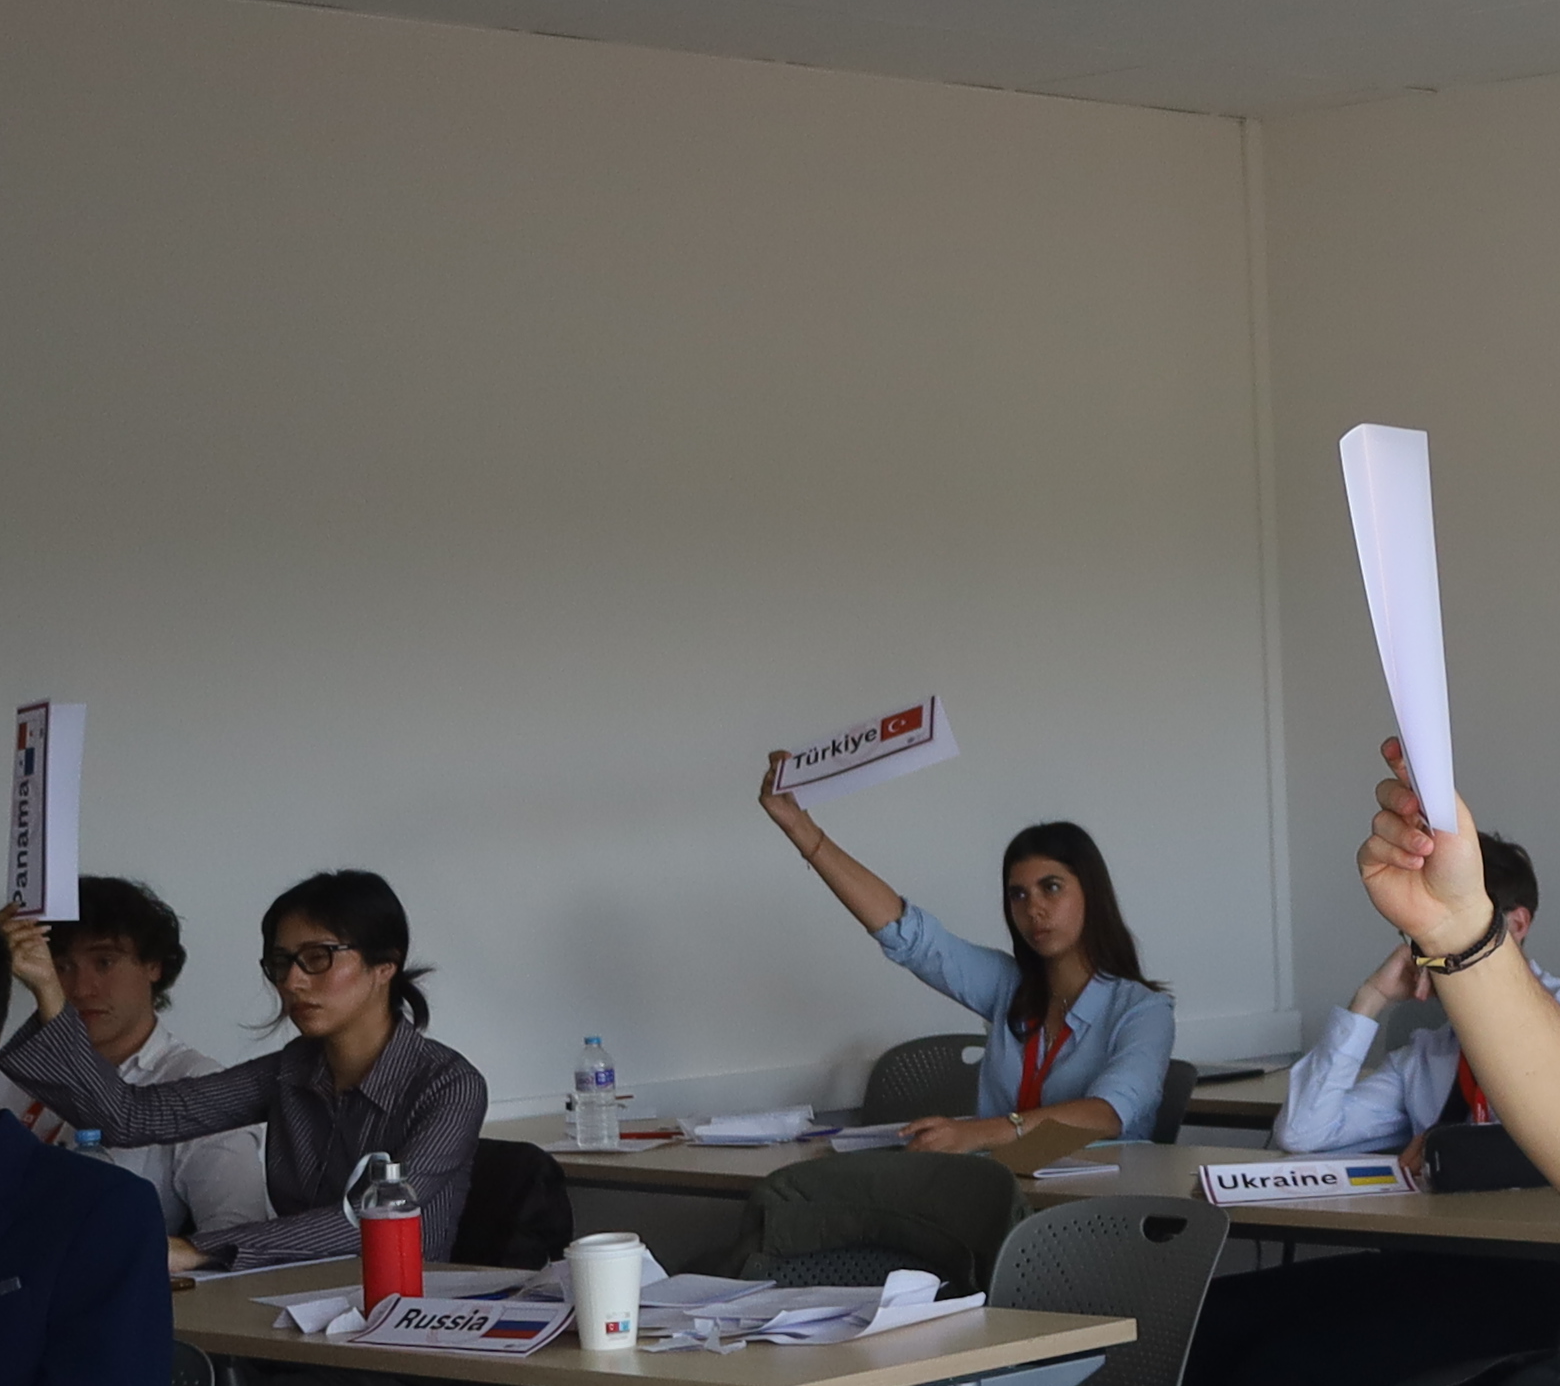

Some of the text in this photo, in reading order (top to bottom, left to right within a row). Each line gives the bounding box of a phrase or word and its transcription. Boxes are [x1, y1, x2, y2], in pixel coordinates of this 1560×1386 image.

[793, 724, 879, 771] Türkiye
[10, 778, 31, 909] Panama
[1217, 1166, 1339, 1193] Ukraine
[394, 1305, 490, 1335] Russia
